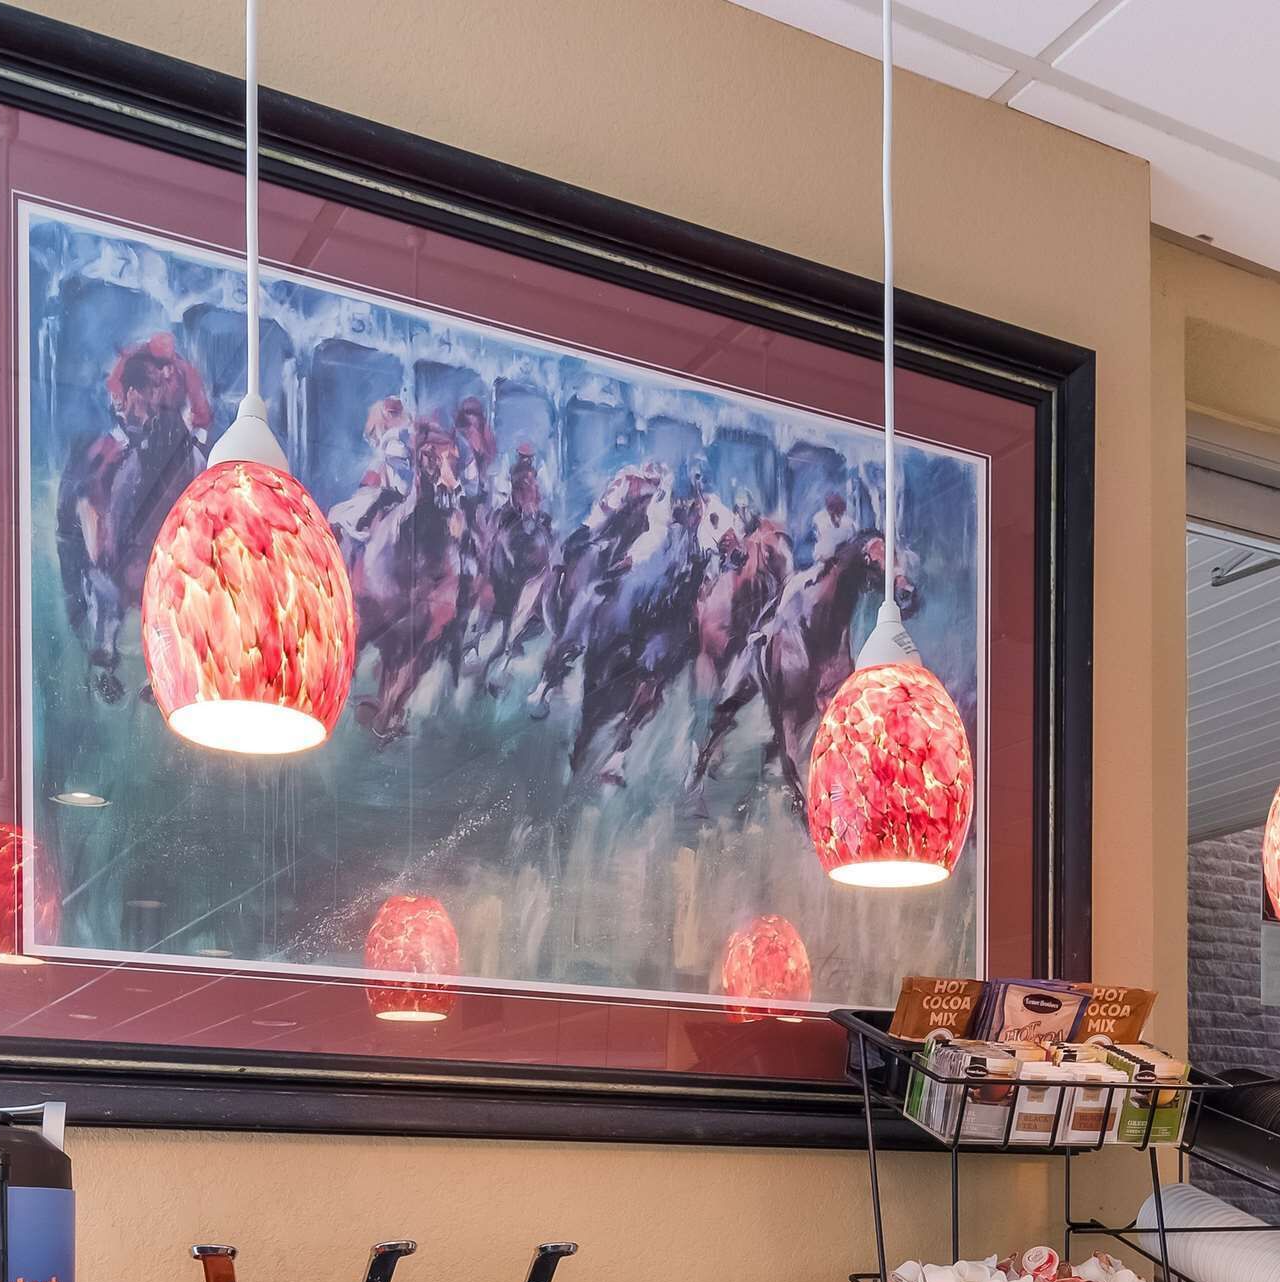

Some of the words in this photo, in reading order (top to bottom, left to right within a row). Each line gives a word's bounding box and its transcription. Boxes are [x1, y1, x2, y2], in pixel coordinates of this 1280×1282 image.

[934, 980, 968, 994] HOT
[1093, 988, 1128, 1002] HOT
[922, 995, 971, 1010] COCOA
[1084, 1003, 1131, 1017] OCOA
[929, 1012, 958, 1026] MIX
[1087, 1018, 1117, 1033] MIX
